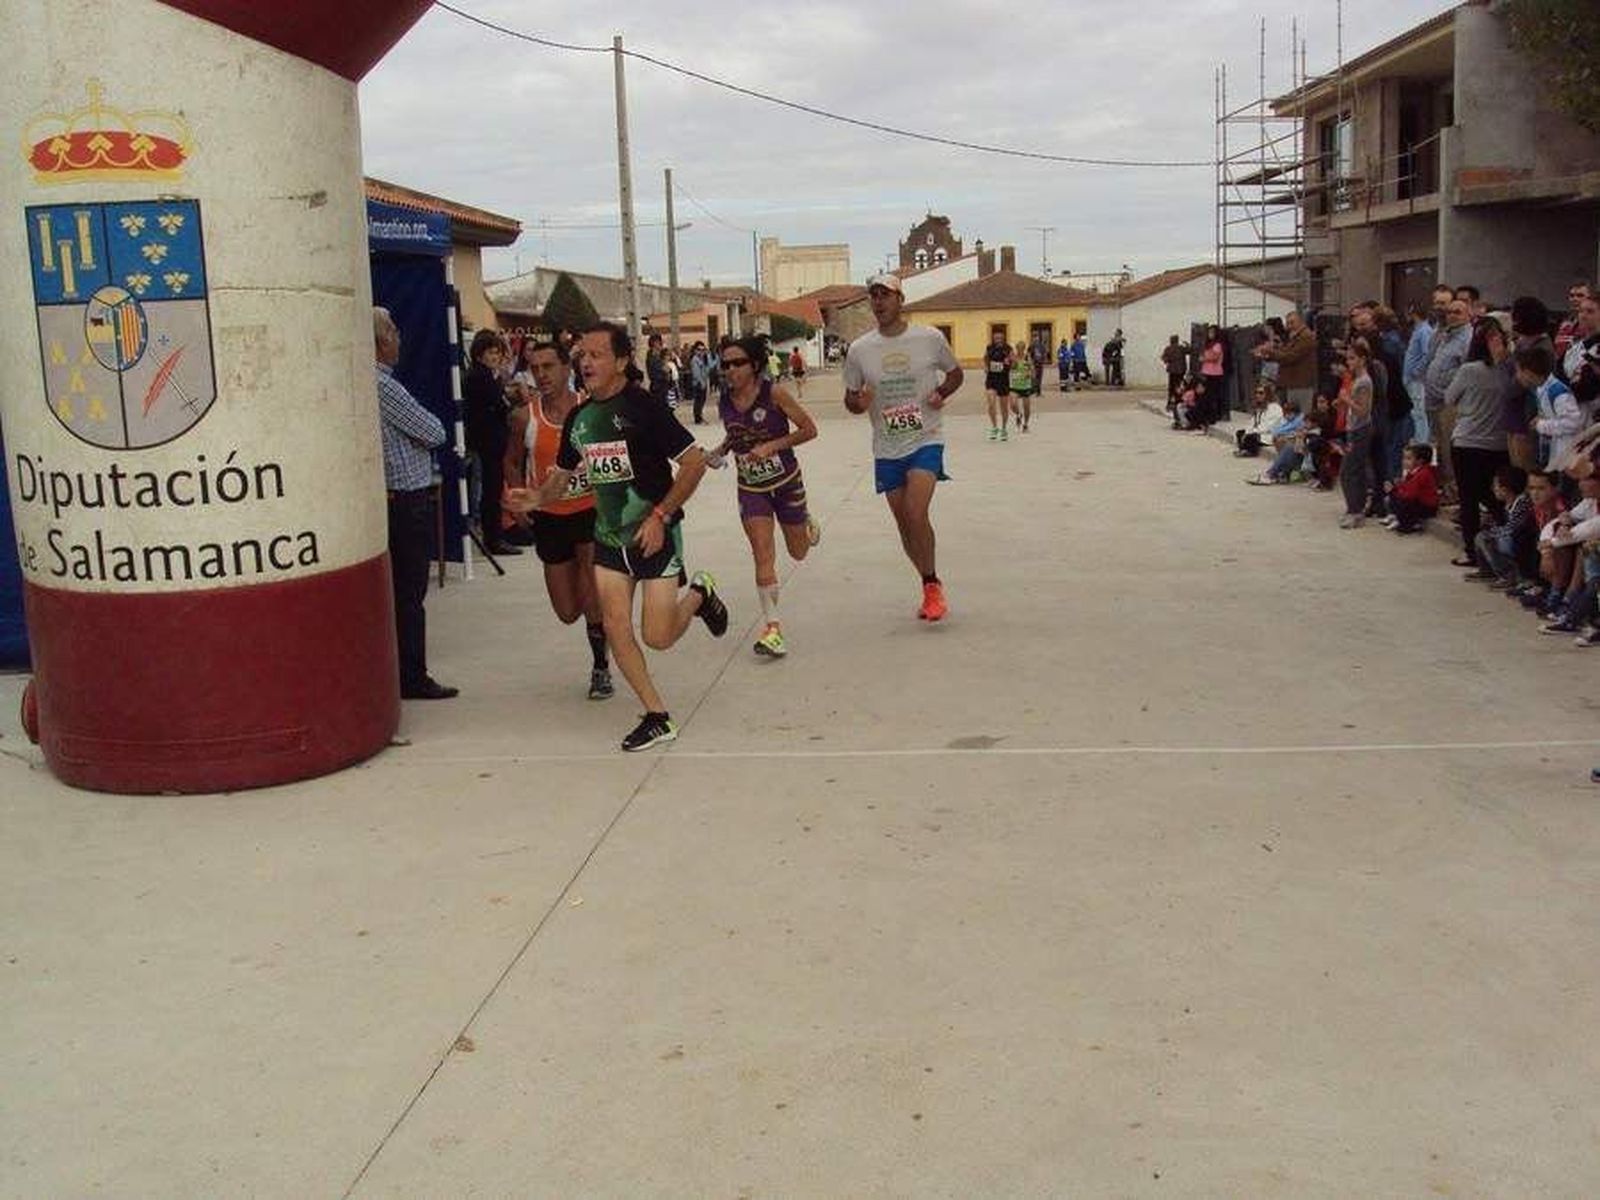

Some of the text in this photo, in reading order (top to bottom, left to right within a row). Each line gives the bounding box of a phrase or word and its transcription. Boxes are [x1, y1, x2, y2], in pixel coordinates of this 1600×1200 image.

[889, 413, 916, 430] 458
[593, 457, 622, 474] 468
[16, 451, 284, 518] Diputación
[47, 529, 320, 581] Salamanca
